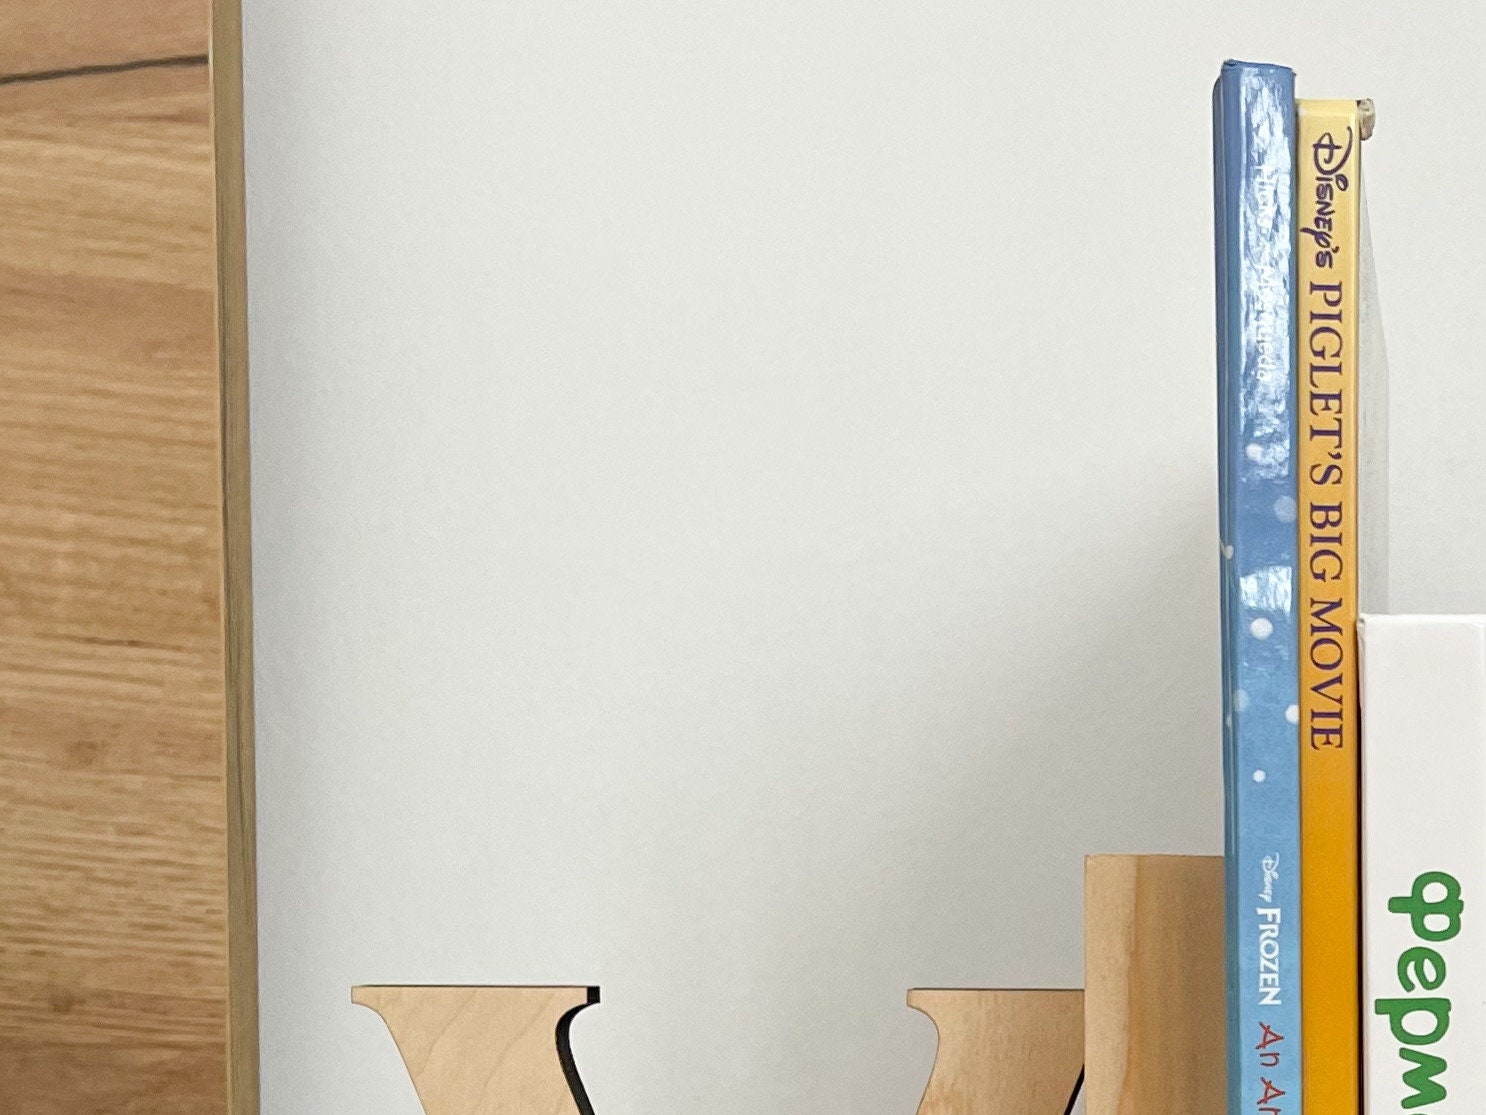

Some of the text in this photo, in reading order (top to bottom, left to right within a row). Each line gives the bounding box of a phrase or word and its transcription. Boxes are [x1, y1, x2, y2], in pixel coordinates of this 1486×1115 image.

[1300, 126, 1353, 753] Disney's PIGLET'S BIG MOVIE
[1256, 854, 1282, 1005] Disney FROZEN
[1256, 1022, 1284, 1068] An
